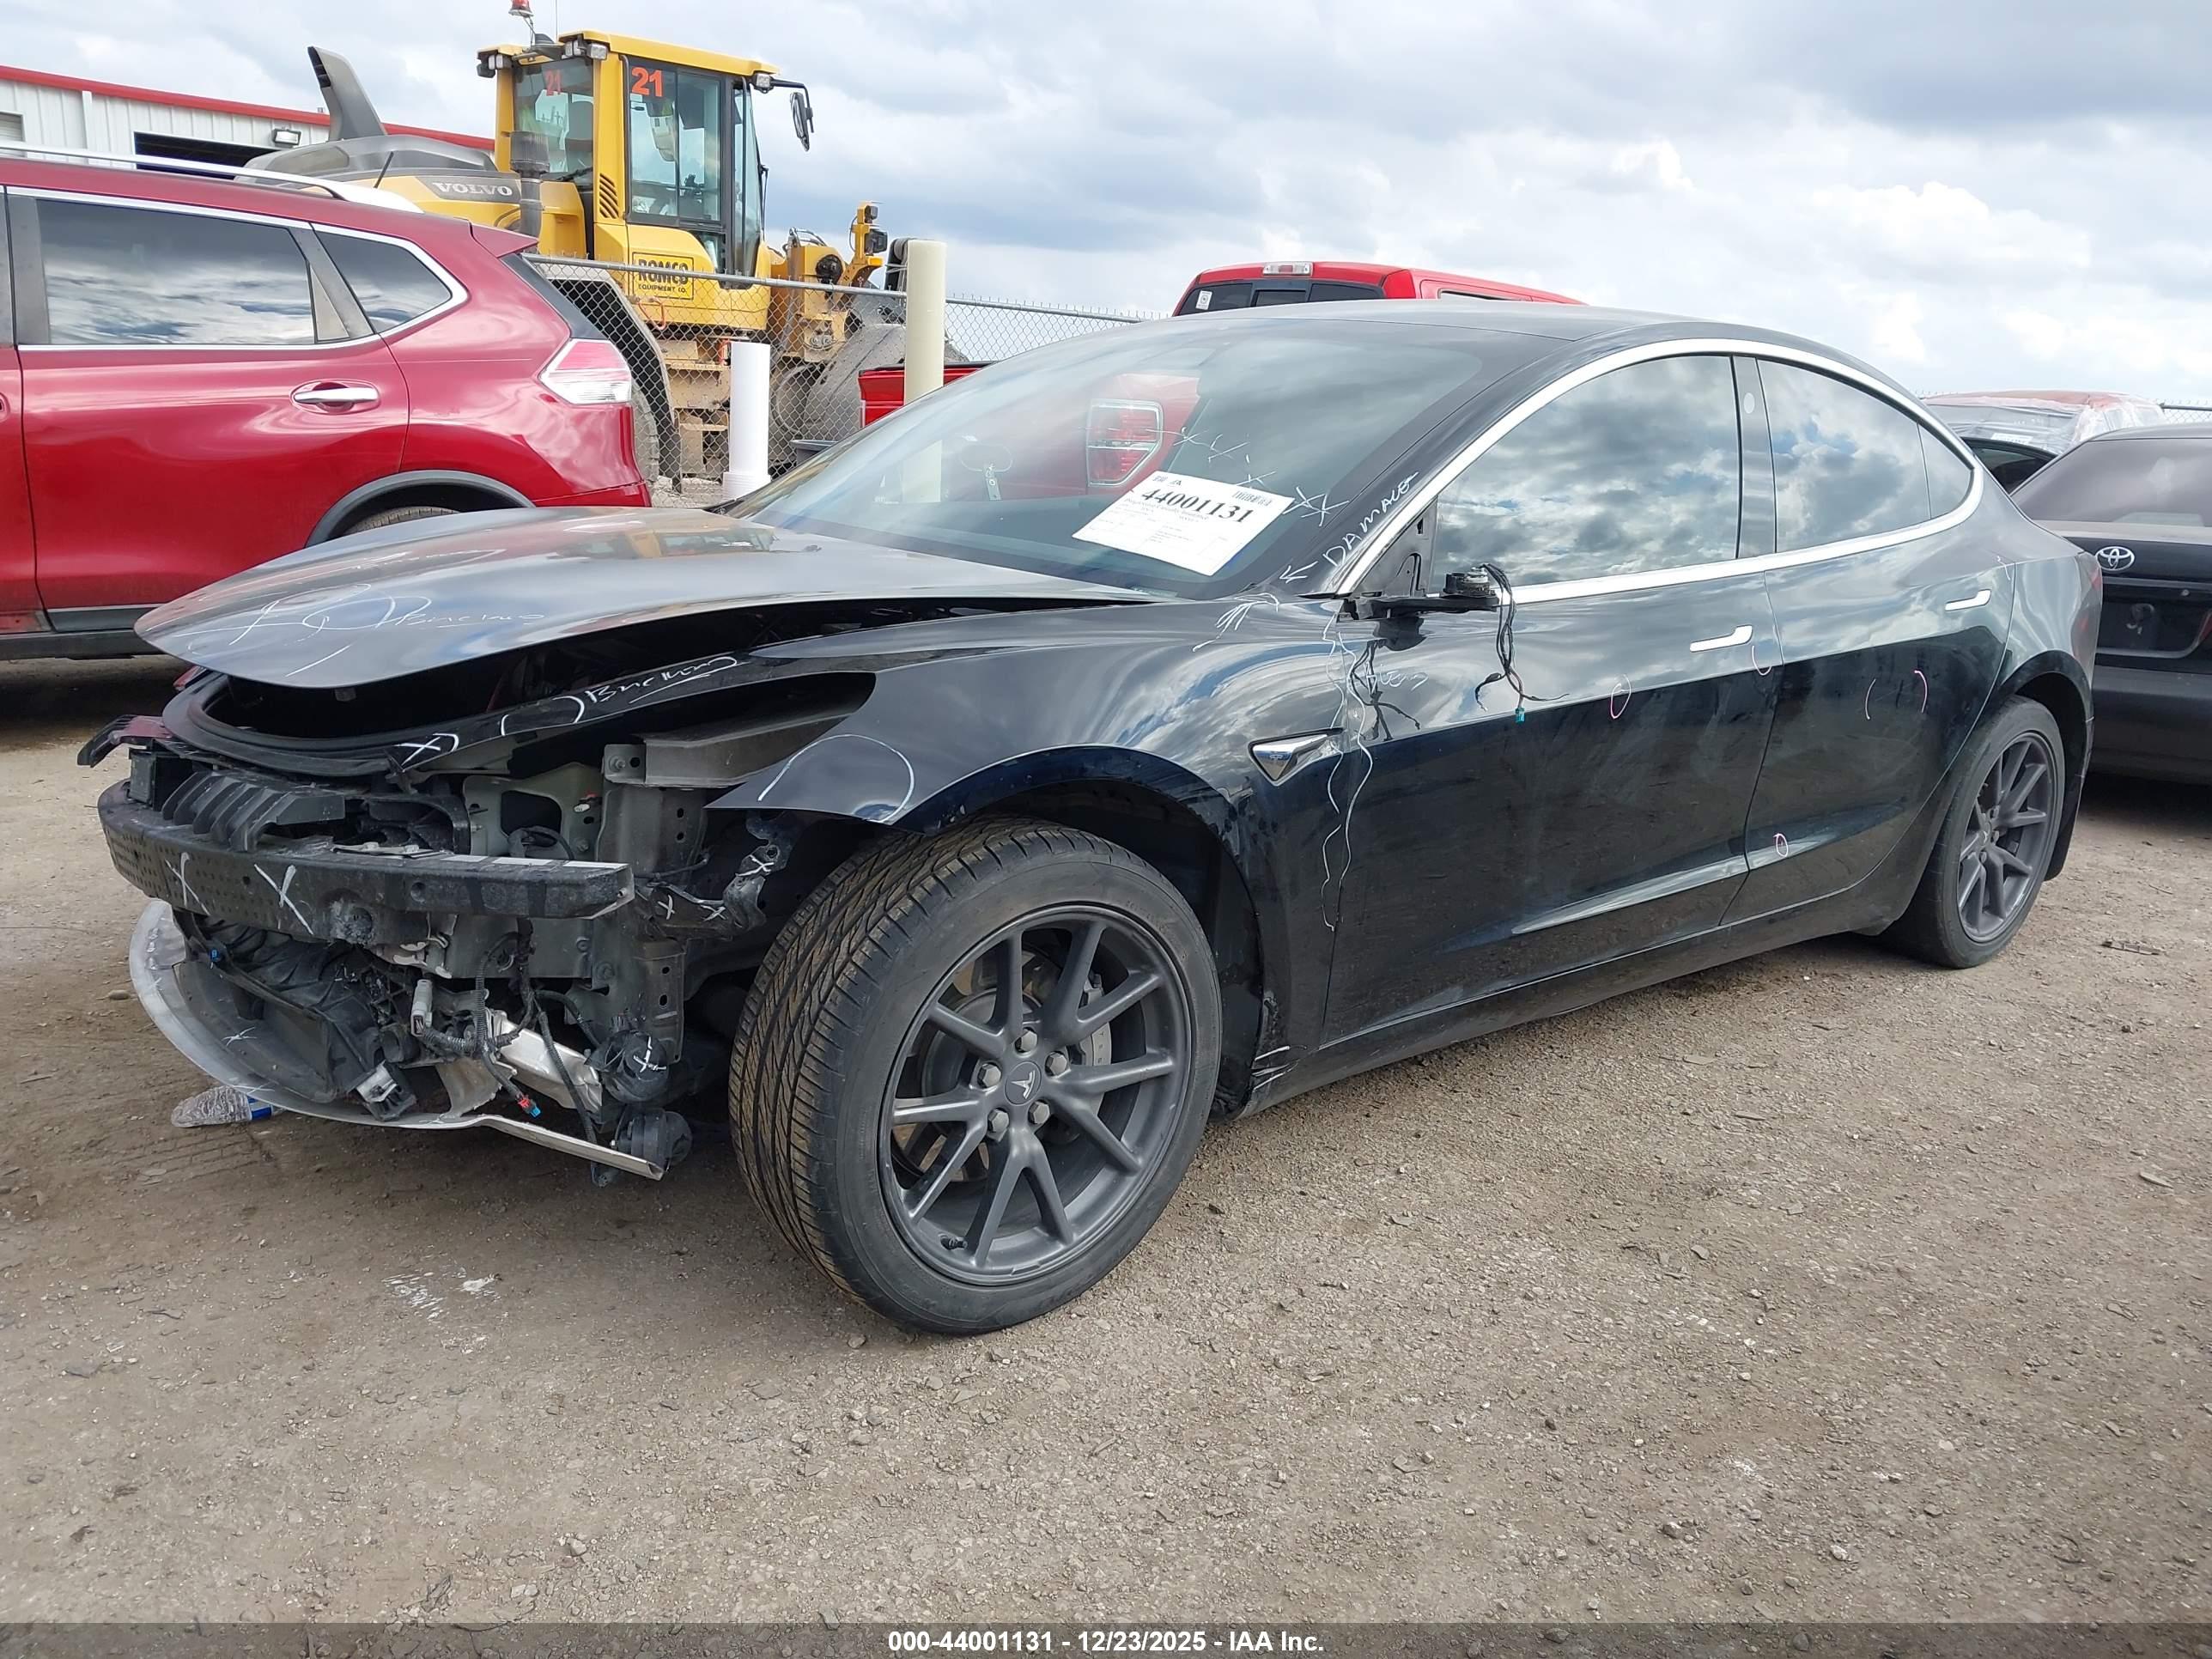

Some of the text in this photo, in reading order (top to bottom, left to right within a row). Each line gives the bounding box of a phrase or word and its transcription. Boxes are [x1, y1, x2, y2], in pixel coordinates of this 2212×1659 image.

[545, 70, 562, 96] 21
[631, 66, 663, 98] 21
[432, 182, 513, 196] VOLVO
[638, 258, 689, 285] ROMCO
[1141, 489, 1254, 523] 44001131
